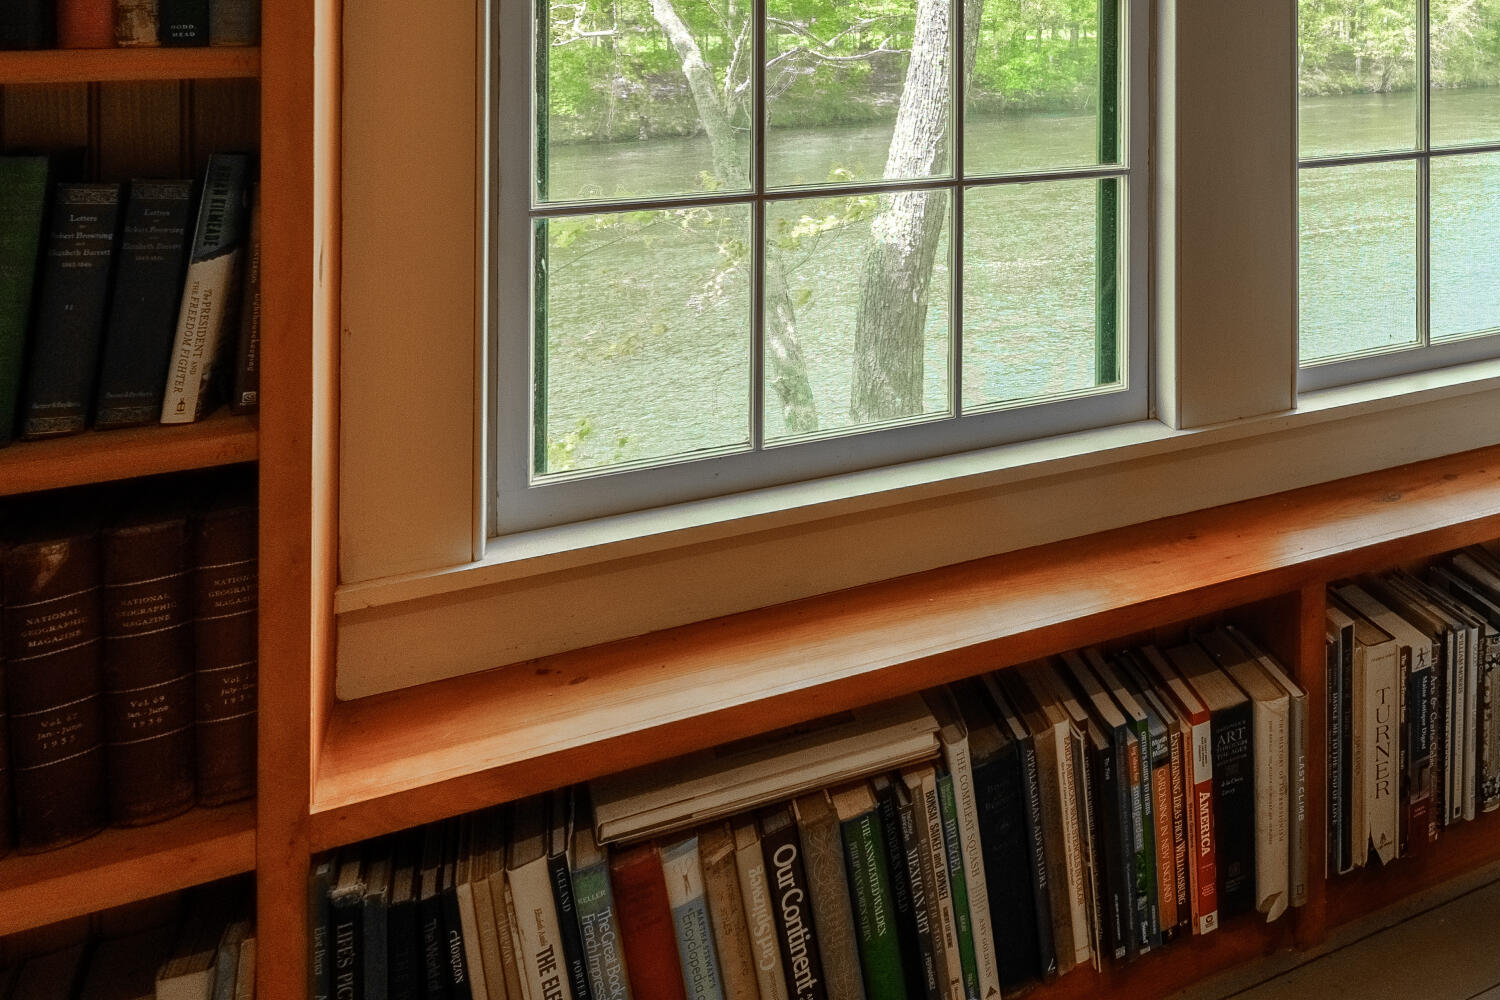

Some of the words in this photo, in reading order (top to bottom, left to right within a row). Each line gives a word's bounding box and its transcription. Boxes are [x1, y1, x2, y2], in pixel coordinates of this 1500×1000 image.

[203, 197, 226, 248] KILMEADE
[180, 295, 199, 346] FREEDOM
[192, 300, 211, 357] PRESIDENT
[173, 347, 191, 393] FIGHTER
[1218, 726, 1246, 746] ART
[1376, 686, 1391, 800] TURNER
[954, 748, 968, 773] THE
[1168, 732, 1182, 793] ENTERTAINING
[957, 773, 975, 832] COMPLEAT
[1024, 749, 1041, 821] APPALACHIAN
[1156, 768, 1168, 820] GARDENING
[859, 817, 871, 837] THE
[1171, 795, 1183, 820] IDEAS
[1199, 792, 1211, 857] AMERICA
[1159, 826, 1169, 835] IN
[1159, 839, 1170, 856] NEW
[1172, 821, 1184, 841] FROM
[772, 843, 801, 887] Our
[863, 839, 880, 897] ANNOTATED
[964, 833, 980, 877] SQUASH
[1032, 825, 1048, 889] ADVENTURE
[1173, 842, 1187, 905] WILLIAMSBURG
[554, 867, 571, 912] ICELAND
[578, 889, 607, 905] KELLER
[904, 846, 926, 906] MEXICAN
[915, 909, 931, 934] ART
[1161, 862, 1172, 902] ENGLAND
[581, 913, 598, 952] French
[597, 906, 614, 930] The
[779, 887, 817, 991] Continent
[872, 897, 887, 937] WALDEN
[533, 944, 557, 977] THE
[601, 929, 620, 963] Great
[571, 959, 586, 996] PORTER
